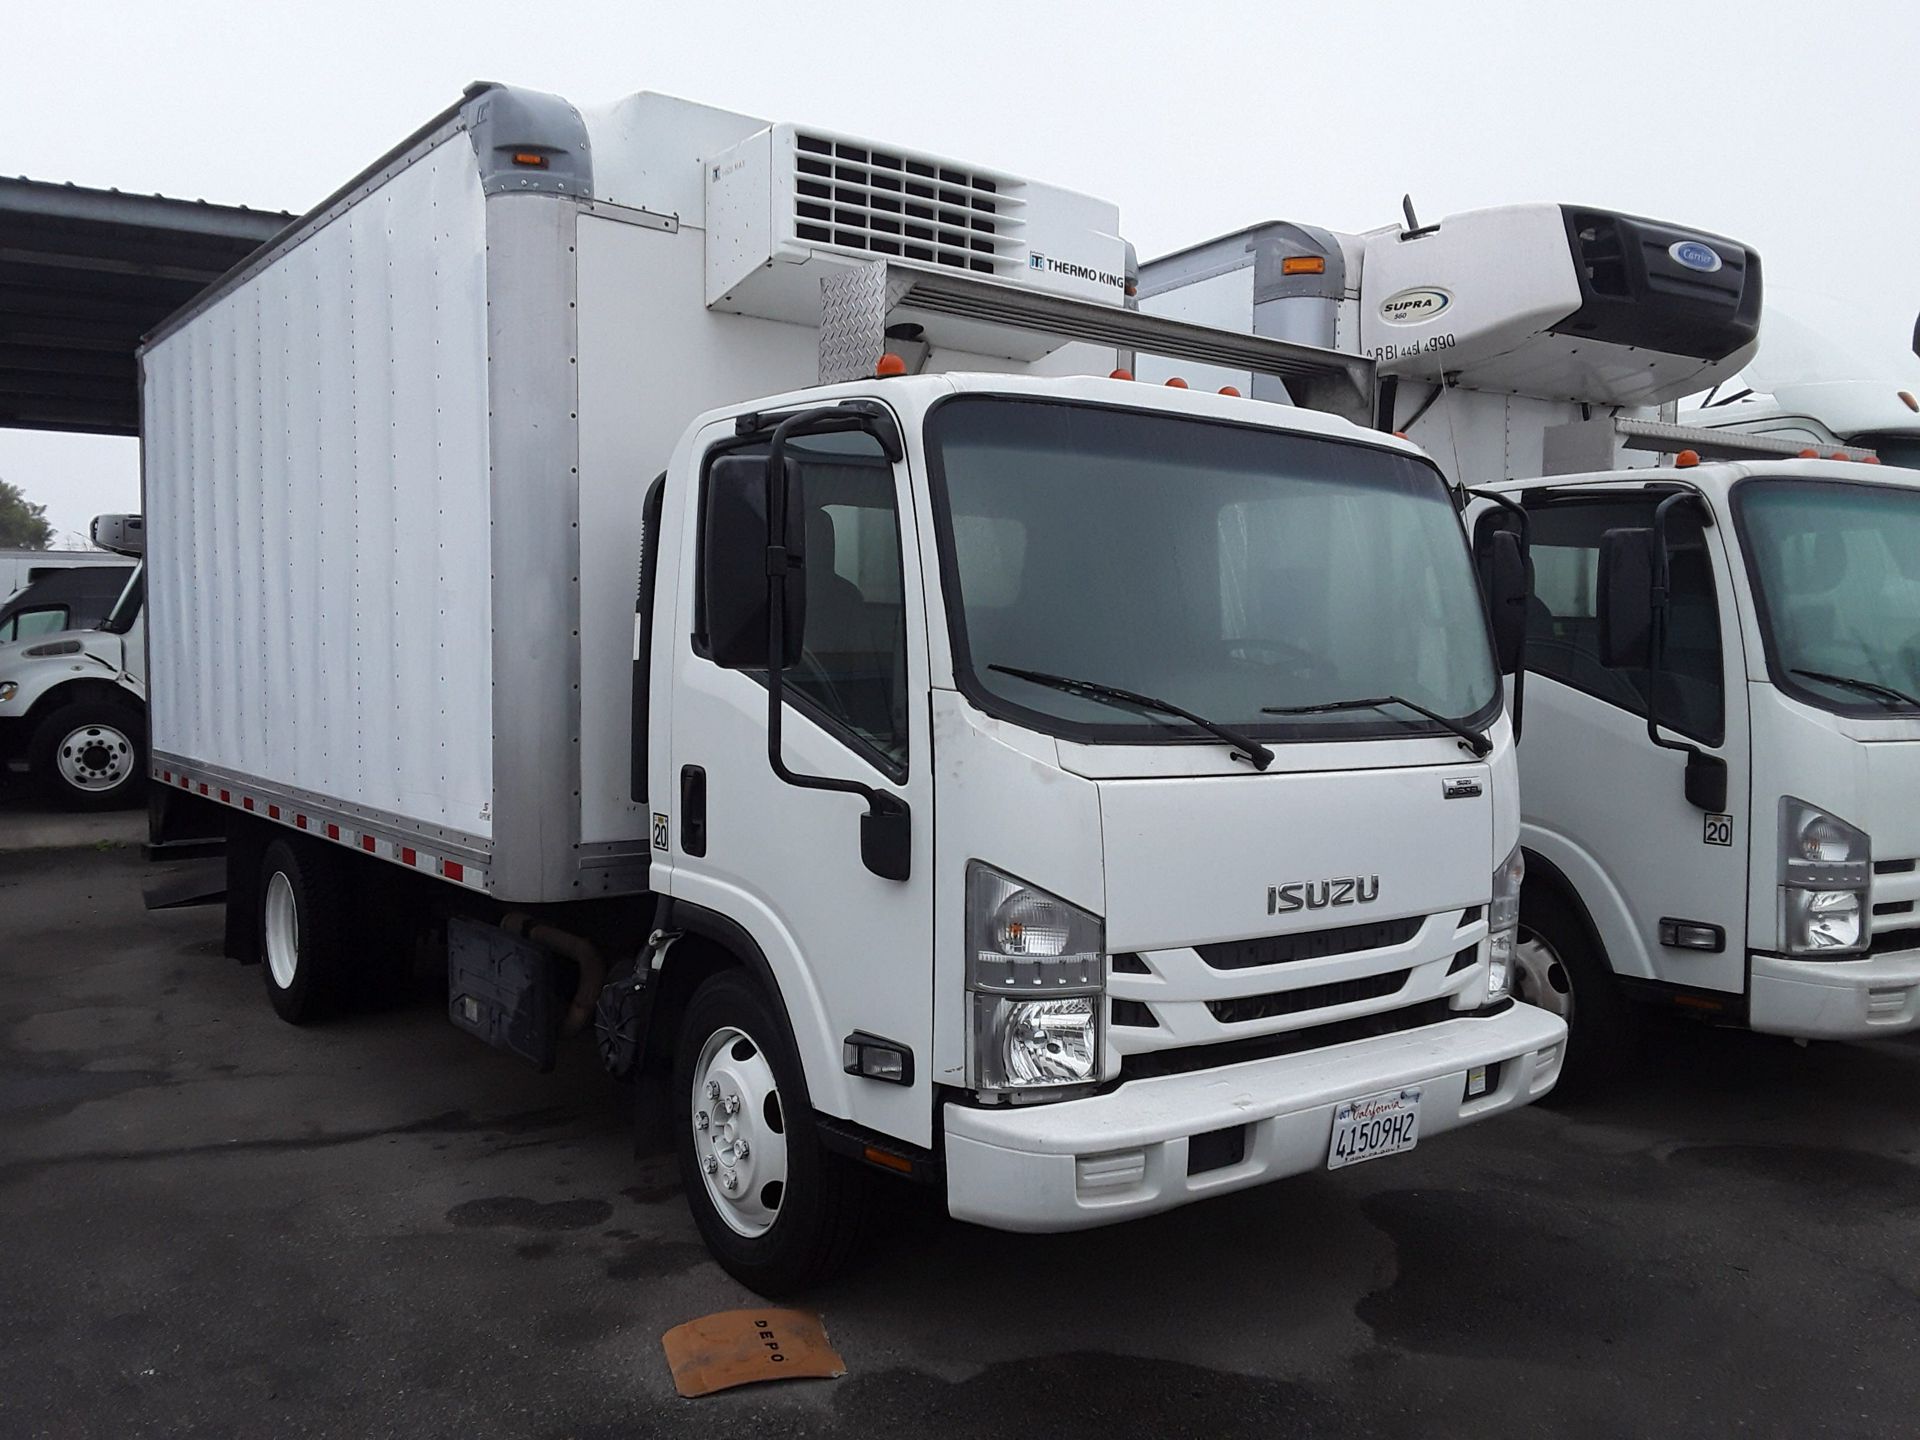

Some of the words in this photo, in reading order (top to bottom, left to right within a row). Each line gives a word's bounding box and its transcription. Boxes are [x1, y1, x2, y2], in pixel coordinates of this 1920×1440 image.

[1683, 248, 1712, 263] Carrier
[1046, 258, 1097, 281] THERMO
[1098, 271, 1124, 289] KING
[1384, 298, 1432, 312] SUPRA
[655, 823, 667, 847] 20
[1707, 821, 1729, 843] 20
[1267, 874, 1380, 916] ISUZU
[1352, 1099, 1405, 1121] California
[1336, 1112, 1415, 1158] 41509H2
[754, 1320, 785, 1362] DEPO
